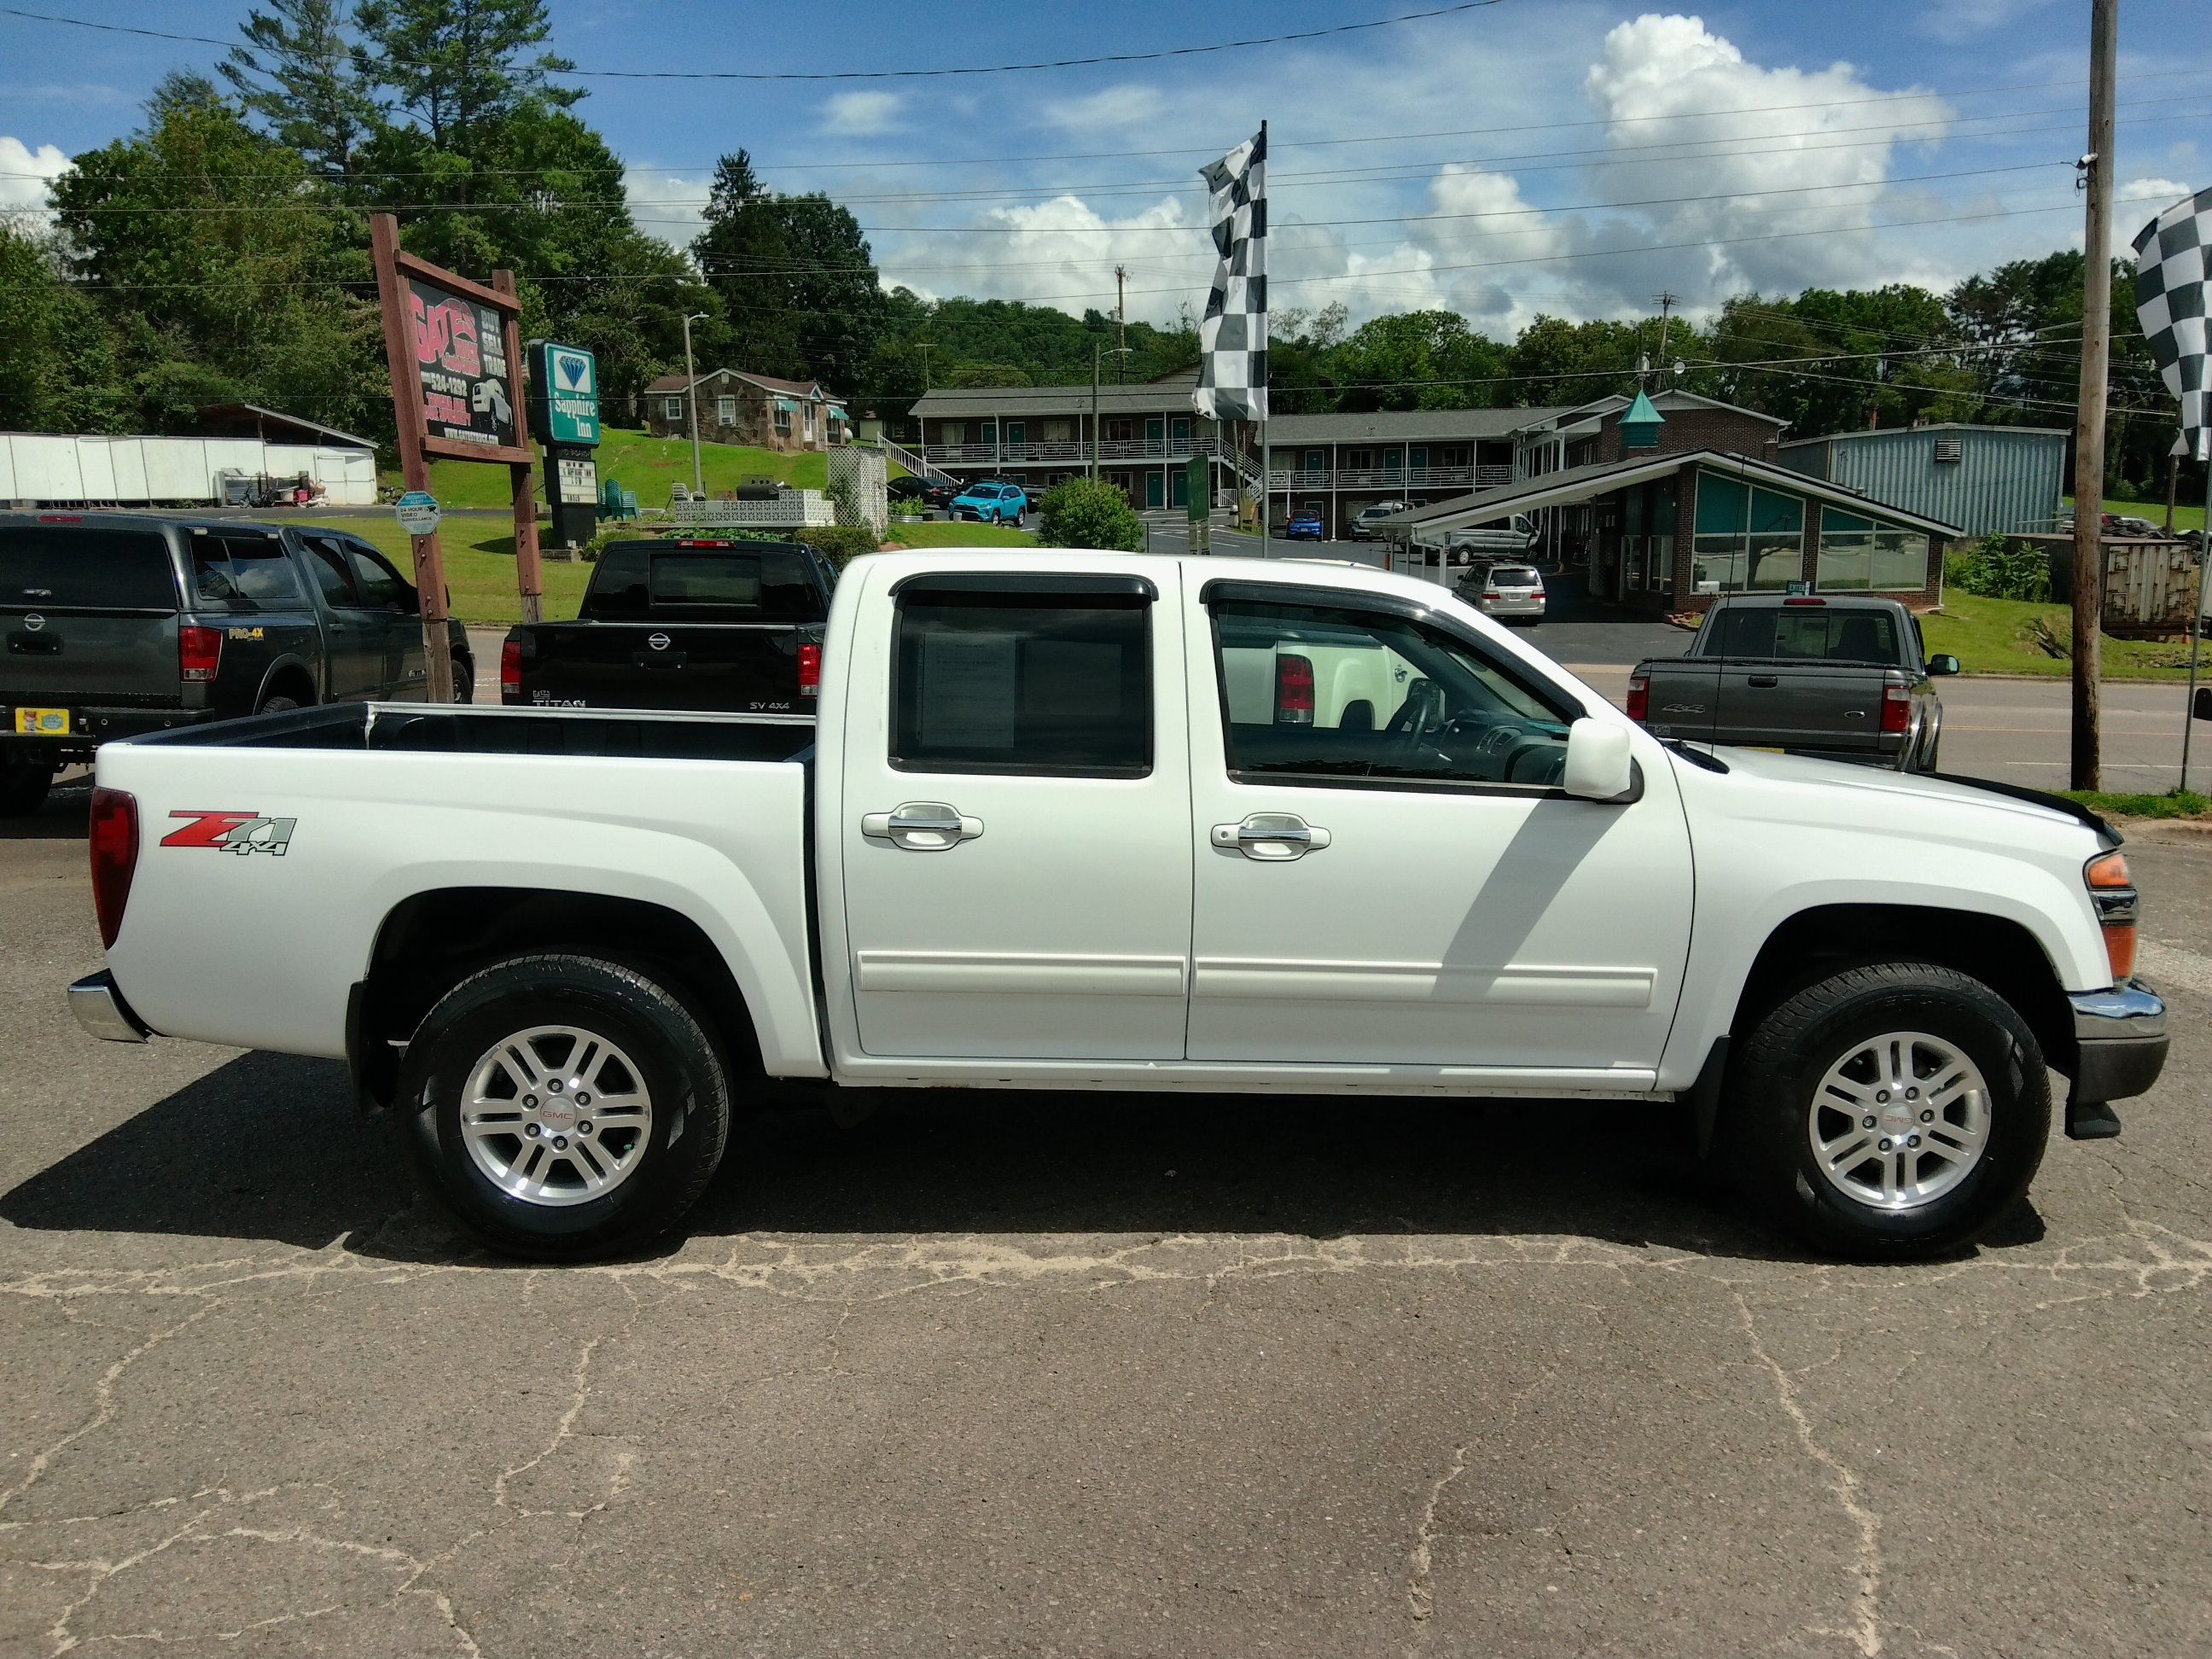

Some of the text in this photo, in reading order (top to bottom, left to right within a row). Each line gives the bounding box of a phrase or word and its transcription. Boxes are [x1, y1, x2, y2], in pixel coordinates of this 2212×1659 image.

[410, 290, 477, 364] GATES
[480, 310, 500, 334] BUY
[482, 331, 504, 357] SELL
[483, 354, 507, 378] TRADE
[555, 391, 596, 419] Sapphire
[576, 416, 592, 439] Inn
[229, 627, 265, 639] PRO-4X
[533, 700, 586, 708] TITAN
[750, 701, 765, 710] SV
[160, 810, 298, 847] Z71
[543, 1110, 574, 1120] GMC
[1883, 1115, 1913, 1124] GMC
